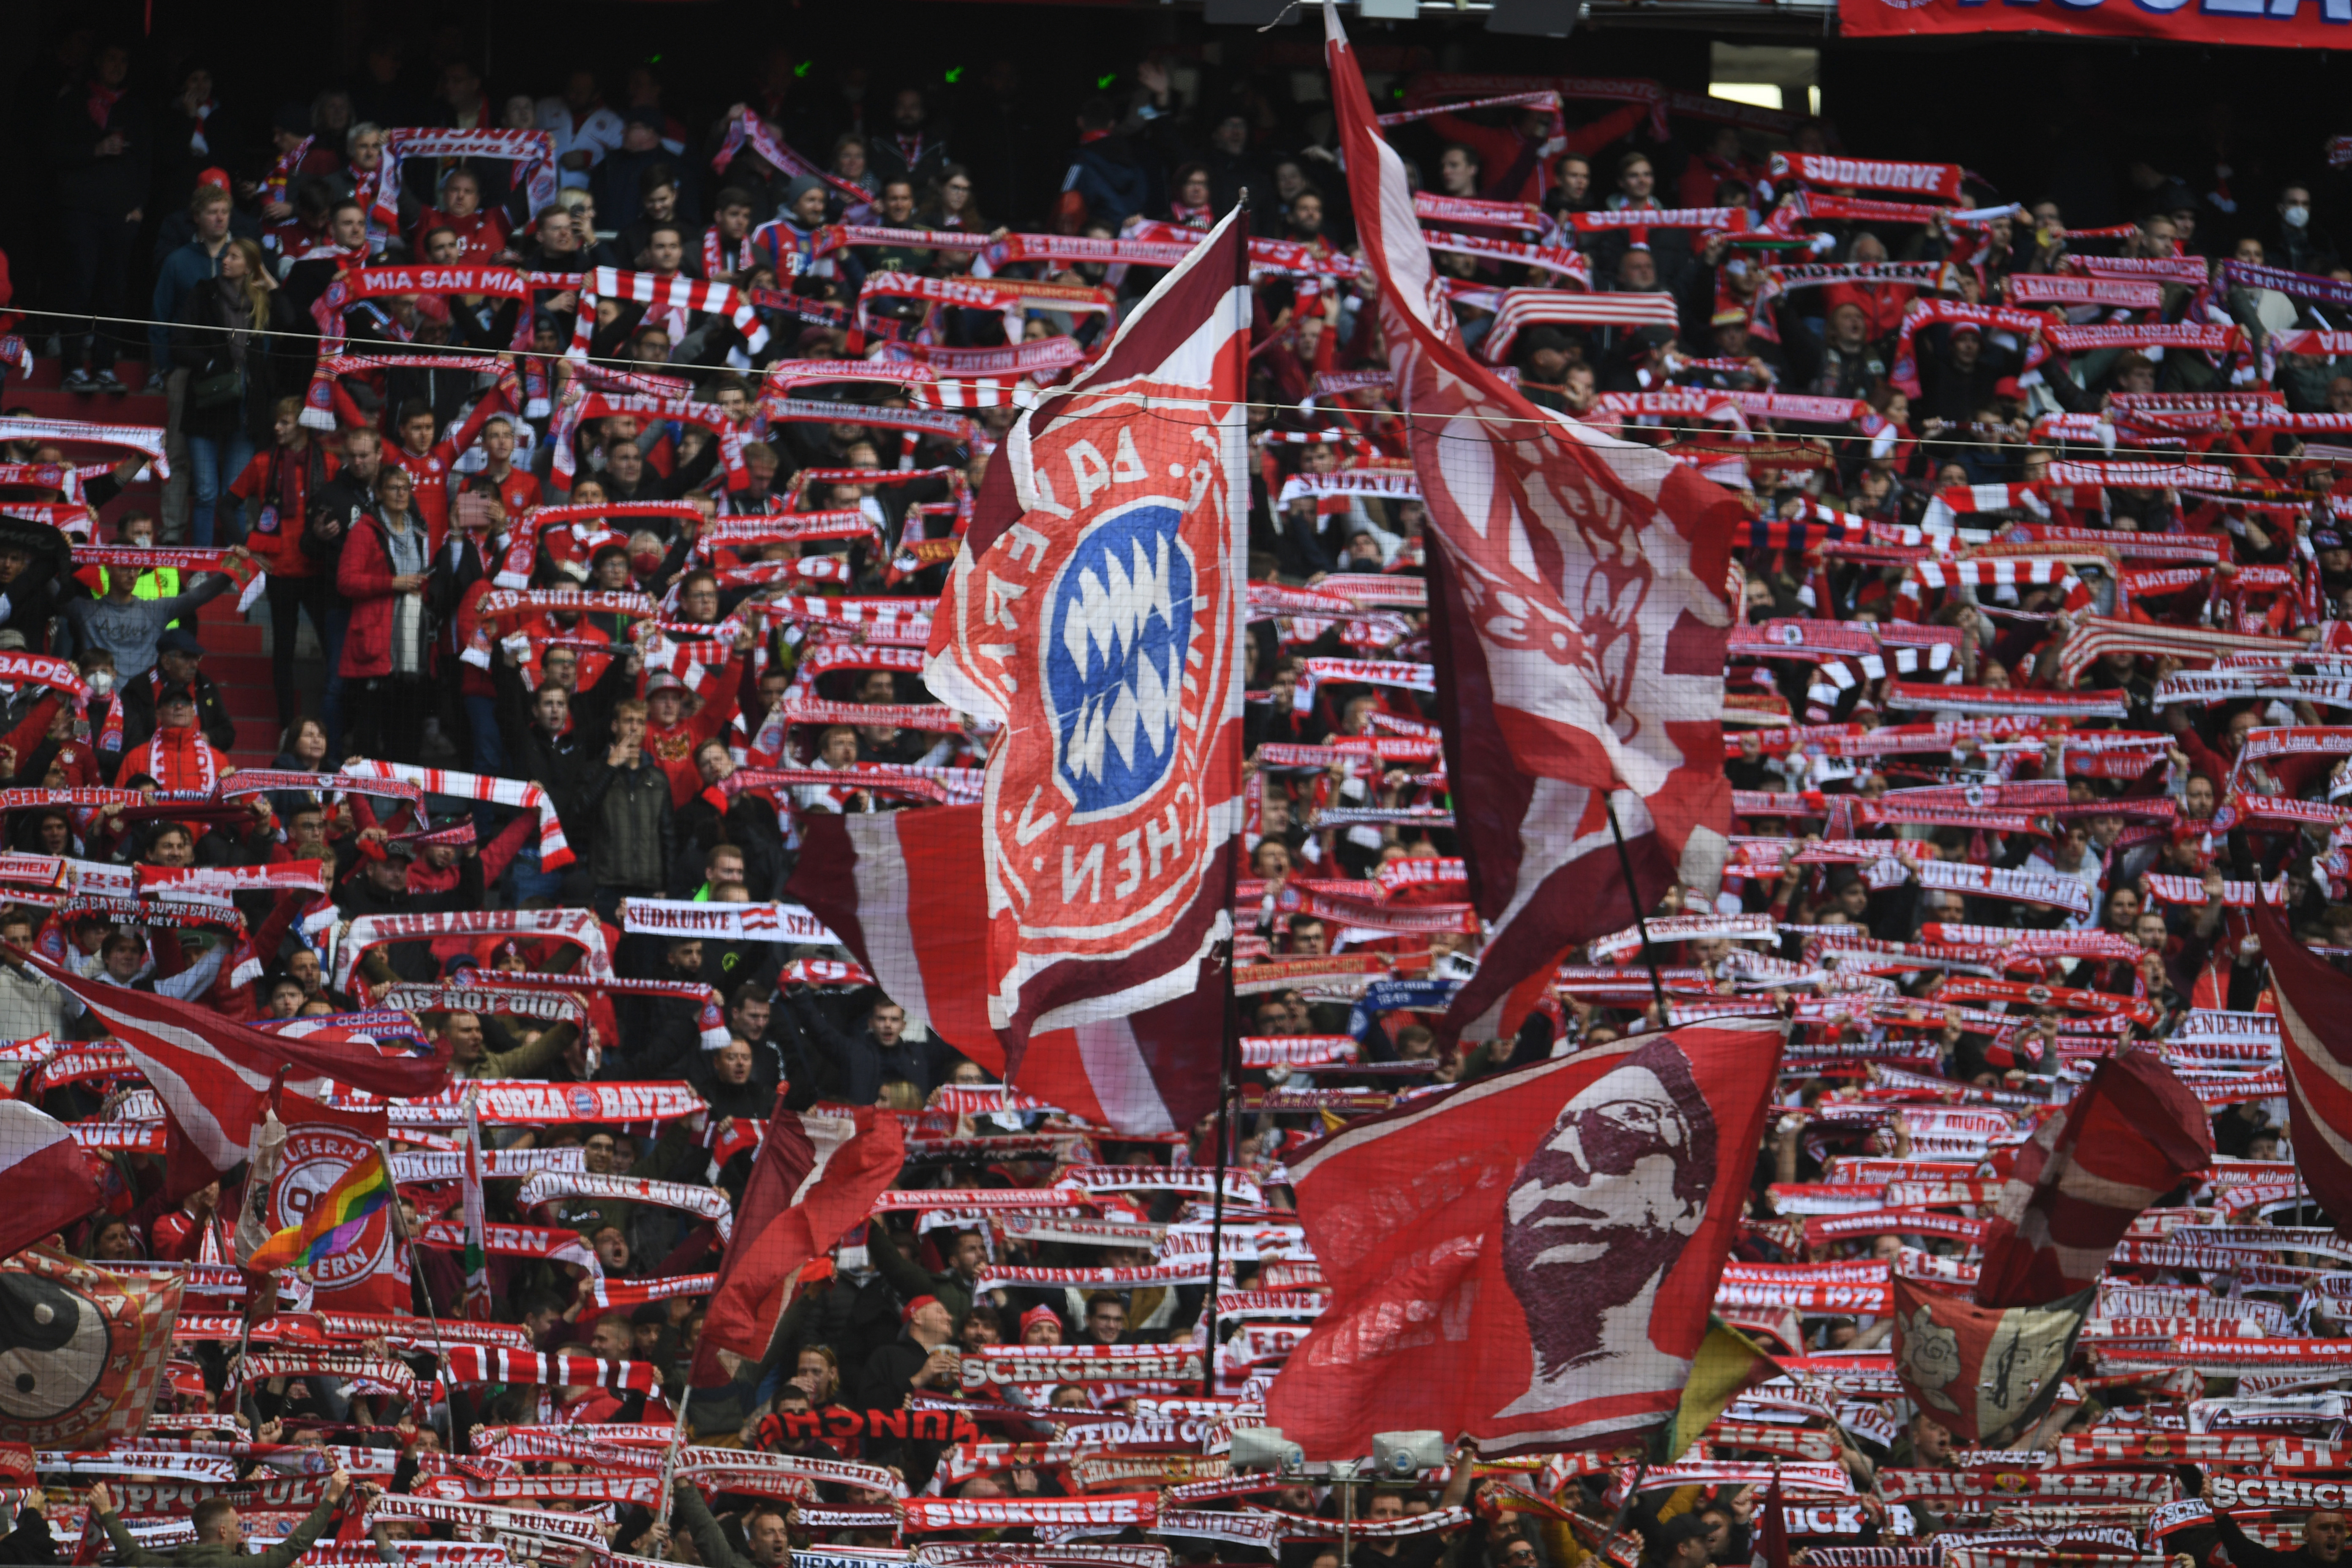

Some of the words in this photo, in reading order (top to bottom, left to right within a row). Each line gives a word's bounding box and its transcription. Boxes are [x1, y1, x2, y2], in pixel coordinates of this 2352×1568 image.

[1802, 155, 1946, 191] SÜDKURVE
[1467, 236, 1527, 254] SAN
[1535, 245, 1586, 275] MIA
[2144, 257, 2205, 277] MÜNCHE
[362, 271, 413, 291] MIA
[420, 271, 473, 288] SAN
[480, 271, 525, 293] MIA
[1784, 265, 1930, 278] MÜNCHEN
[2028, 279, 2091, 298] BAYERN
[2095, 282, 2159, 304] MÜNCHE
[1900, 300, 1934, 339] MIA
[1937, 300, 1990, 321] SAN
[1996, 309, 2042, 329] MIA
[1301, 473, 1421, 494] SÜDKUR
[71, 555, 100, 564] RLIN
[2136, 567, 2201, 587] BAYERN
[486, 589, 653, 612] ED-WHITE-CHIN
[95, 618, 148, 642] Active
[815, 647, 924, 668] BAYER
[1314, 662, 1418, 682] DKURVE
[2158, 678, 2243, 694] DKURVE
[1377, 740, 1434, 757] AYERN
[2247, 795, 2270, 811] FC
[2279, 797, 2336, 819] BAYERN
[0, 860, 51, 874] CHEN
[1867, 858, 1985, 890] SÜDURVE
[1989, 867, 2090, 910] MÜNCHE
[148, 901, 187, 916] SUPER
[371, 911, 516, 937] BAYERN
[626, 903, 731, 931] SÜDKURVE
[786, 912, 830, 938] SEIT
[1235, 964, 1285, 983] AYERN
[1375, 981, 1435, 993] BOCHUM
[443, 991, 500, 1013] ROT
[336, 1012, 402, 1027] adidas
[62, 1052, 133, 1075] BAYE
[2183, 1044, 2273, 1060] KURVE
[476, 1088, 569, 1119] FORZA
[71, 1123, 160, 1146] KURVE
[391, 1150, 487, 1180] ÜDKURE
[1067, 1166, 1248, 1193] SÜDKURE
[424, 1227, 549, 1252] AYERN
[1040, 1219, 1065, 1233] FC
[1070, 1222, 1151, 1238] BAYERN
[1161, 1233, 1244, 1258] ÜDKUVE
[317, 1246, 368, 1279] ERN
[1112, 1262, 1225, 1282] MÜNCH
[1824, 1287, 1886, 1310] 1972
[2197, 1296, 2286, 1330] MÜNCH
[331, 1316, 411, 1334] KURVE
[444, 1323, 526, 1348] MÜNCH
[2111, 1318, 2242, 1337] BAYERN
[224, 1353, 310, 1391] OREVER
[318, 1353, 415, 1388] SÜDKUR
[961, 1354, 1206, 1387] SCHICKERIA
[1749, 1386, 1833, 1410] ÜNCHEN
[17, 1393, 112, 1440] CHEN
[758, 1402, 979, 1448] MÜNCHE
[597, 1426, 672, 1439] MÜNC
[109, 1436, 167, 1452] SAN
[198, 1439, 251, 1455] MIA
[123, 1453, 175, 1469] SEIT
[675, 1450, 778, 1470] DKURVE
[108, 1481, 216, 1514] UPPO
[264, 1478, 332, 1505] ULT
[436, 1478, 661, 1504] SÜDKURVE
[738, 1473, 803, 1497] MÜNC
[1880, 1471, 1984, 1501] CHIC
[2213, 1477, 2352, 1508] SCHIC
[923, 1499, 1140, 1527] SÜDKURVE
[1210, 1514, 1277, 1547] FUSSBA
[1938, 1529, 2036, 1550] CHICKERIA
[2068, 1527, 2139, 1552] MÜNCH
[435, 1546, 506, 1563] 1972
[1809, 1546, 1936, 1567] DIFFIDATI
